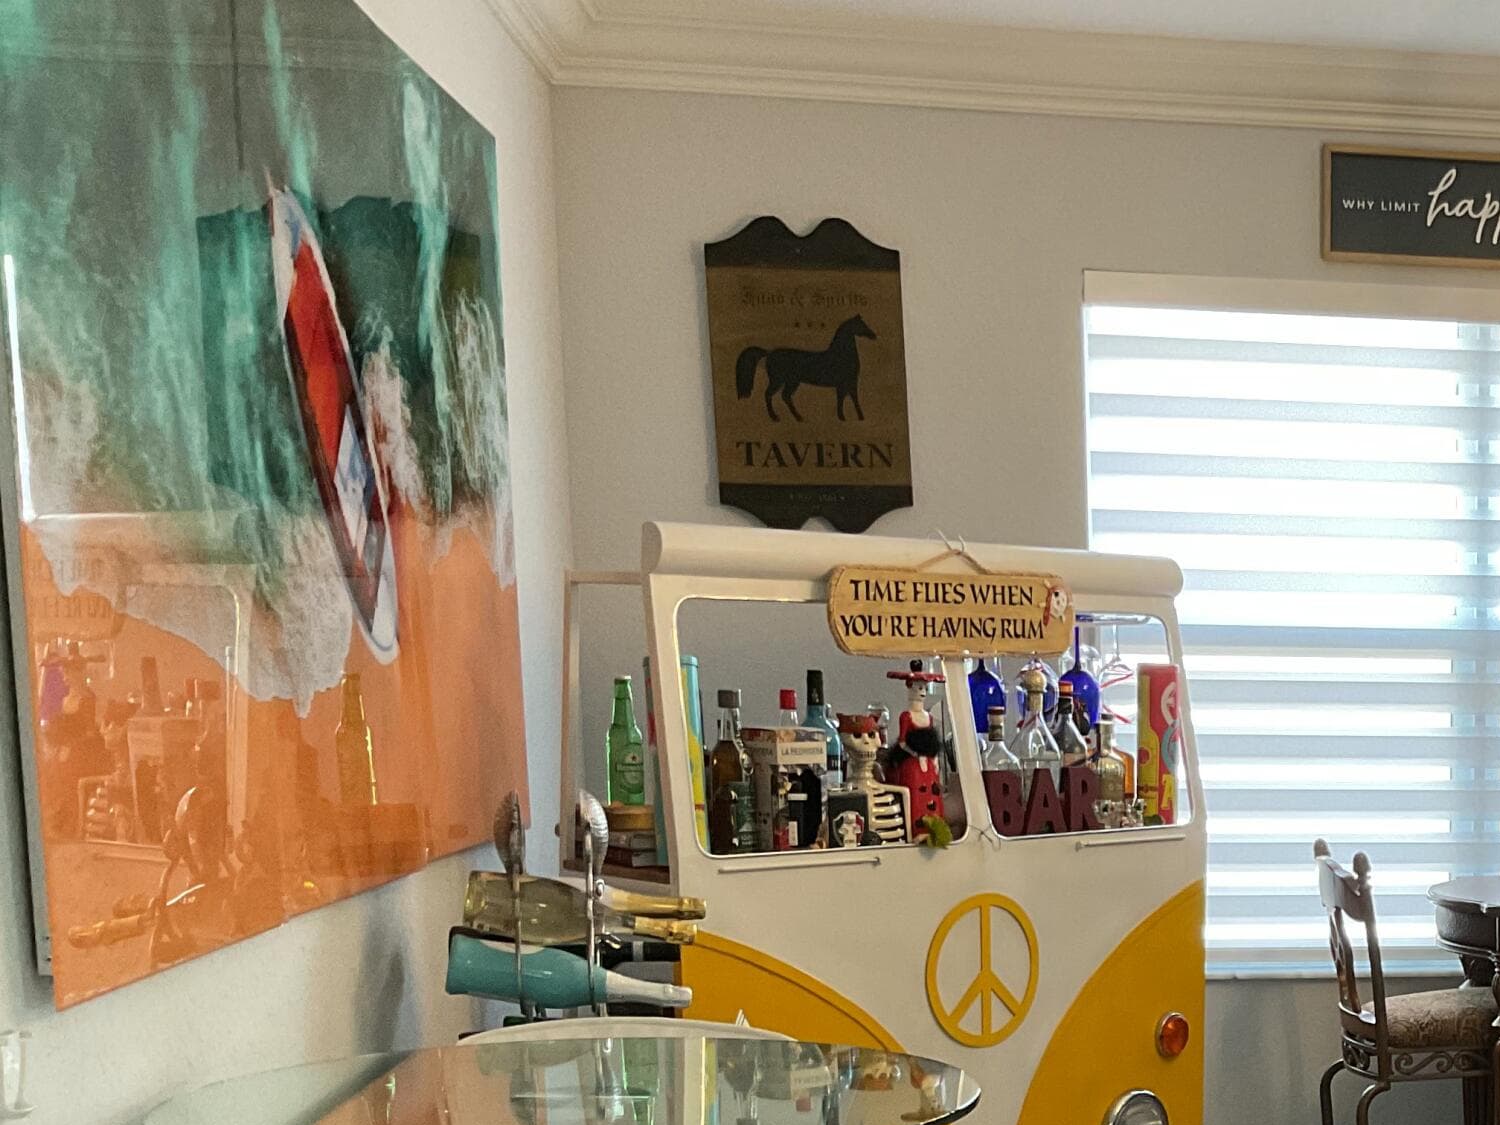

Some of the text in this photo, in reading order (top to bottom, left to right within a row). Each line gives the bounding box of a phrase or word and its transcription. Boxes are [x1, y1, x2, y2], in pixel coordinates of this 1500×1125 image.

[1342, 198, 1375, 211] WHY
[1380, 200, 1421, 213] LIMIT
[735, 441, 894, 469] TAVERN
[850, 579, 1034, 606] TIME FLIES WHEN
[840, 613, 1045, 643] YOU'RE HAVING RUM
[983, 767, 1104, 835] BAR
